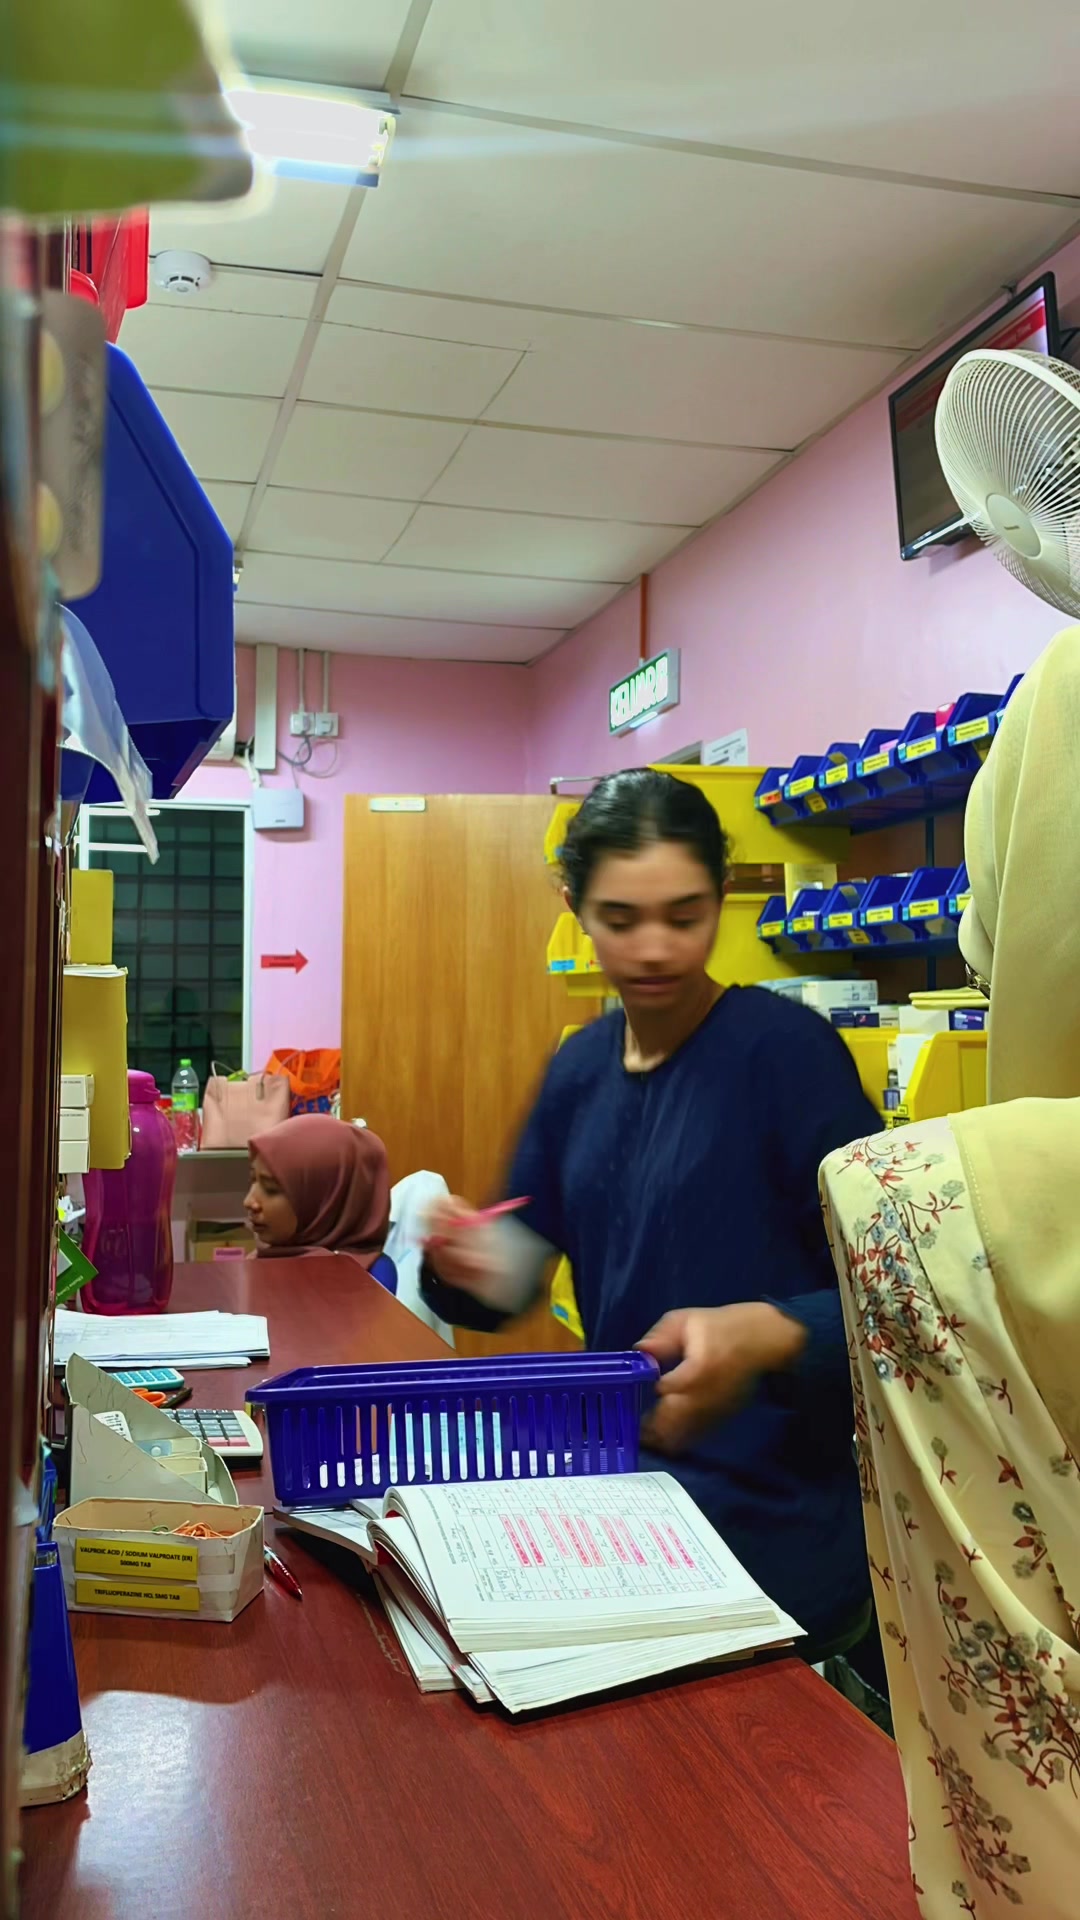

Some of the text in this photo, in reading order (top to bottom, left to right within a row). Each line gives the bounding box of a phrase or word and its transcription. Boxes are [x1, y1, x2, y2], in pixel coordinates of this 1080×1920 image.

[610, 656, 668, 728] KELUAR
[80, 1546, 106, 1555] VALPROIC
[125, 1550, 148, 1558] SODIUM
[149, 1552, 181, 1561] VALPROATE
[95, 1589, 142, 1598] TRIFLUOPERAZINE
